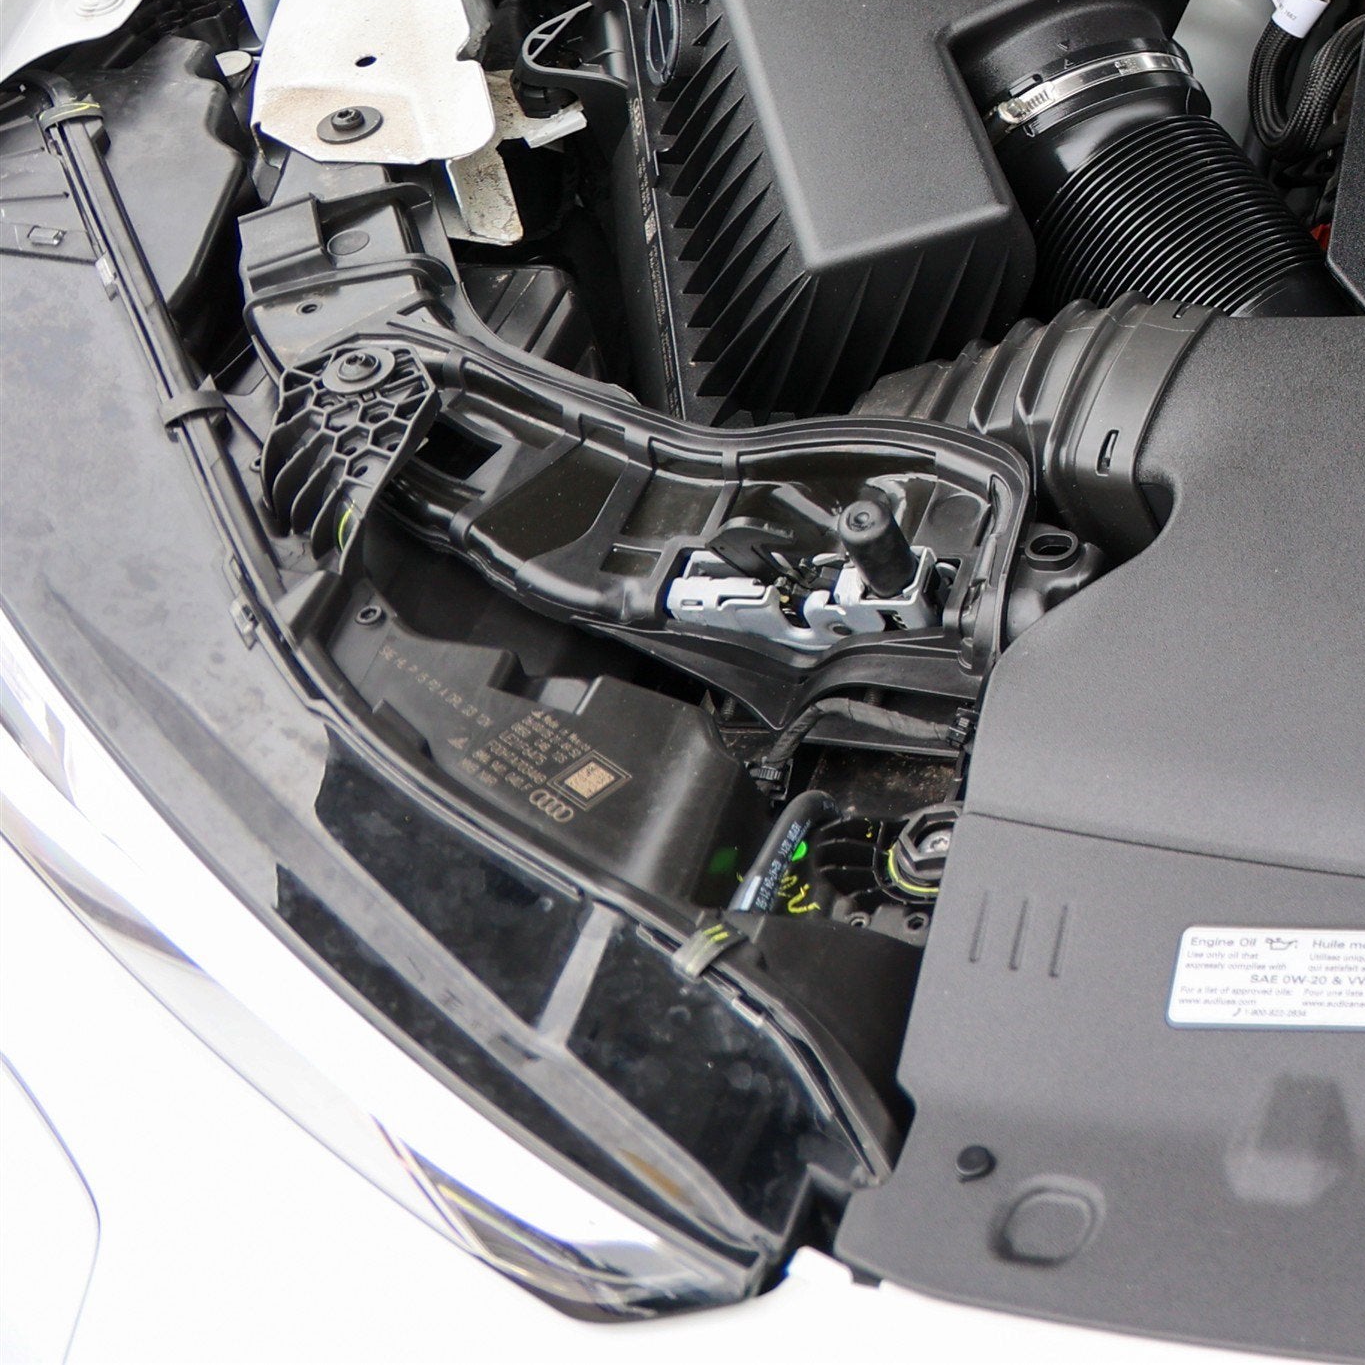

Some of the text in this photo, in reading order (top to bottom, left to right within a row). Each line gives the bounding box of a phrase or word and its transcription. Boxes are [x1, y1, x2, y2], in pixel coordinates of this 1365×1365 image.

[1190, 937, 1257, 948] Engine Oil
[1312, 939, 1345, 949] Huile
[1250, 974, 1278, 984] SAE
[1332, 976, 1342, 986] &
